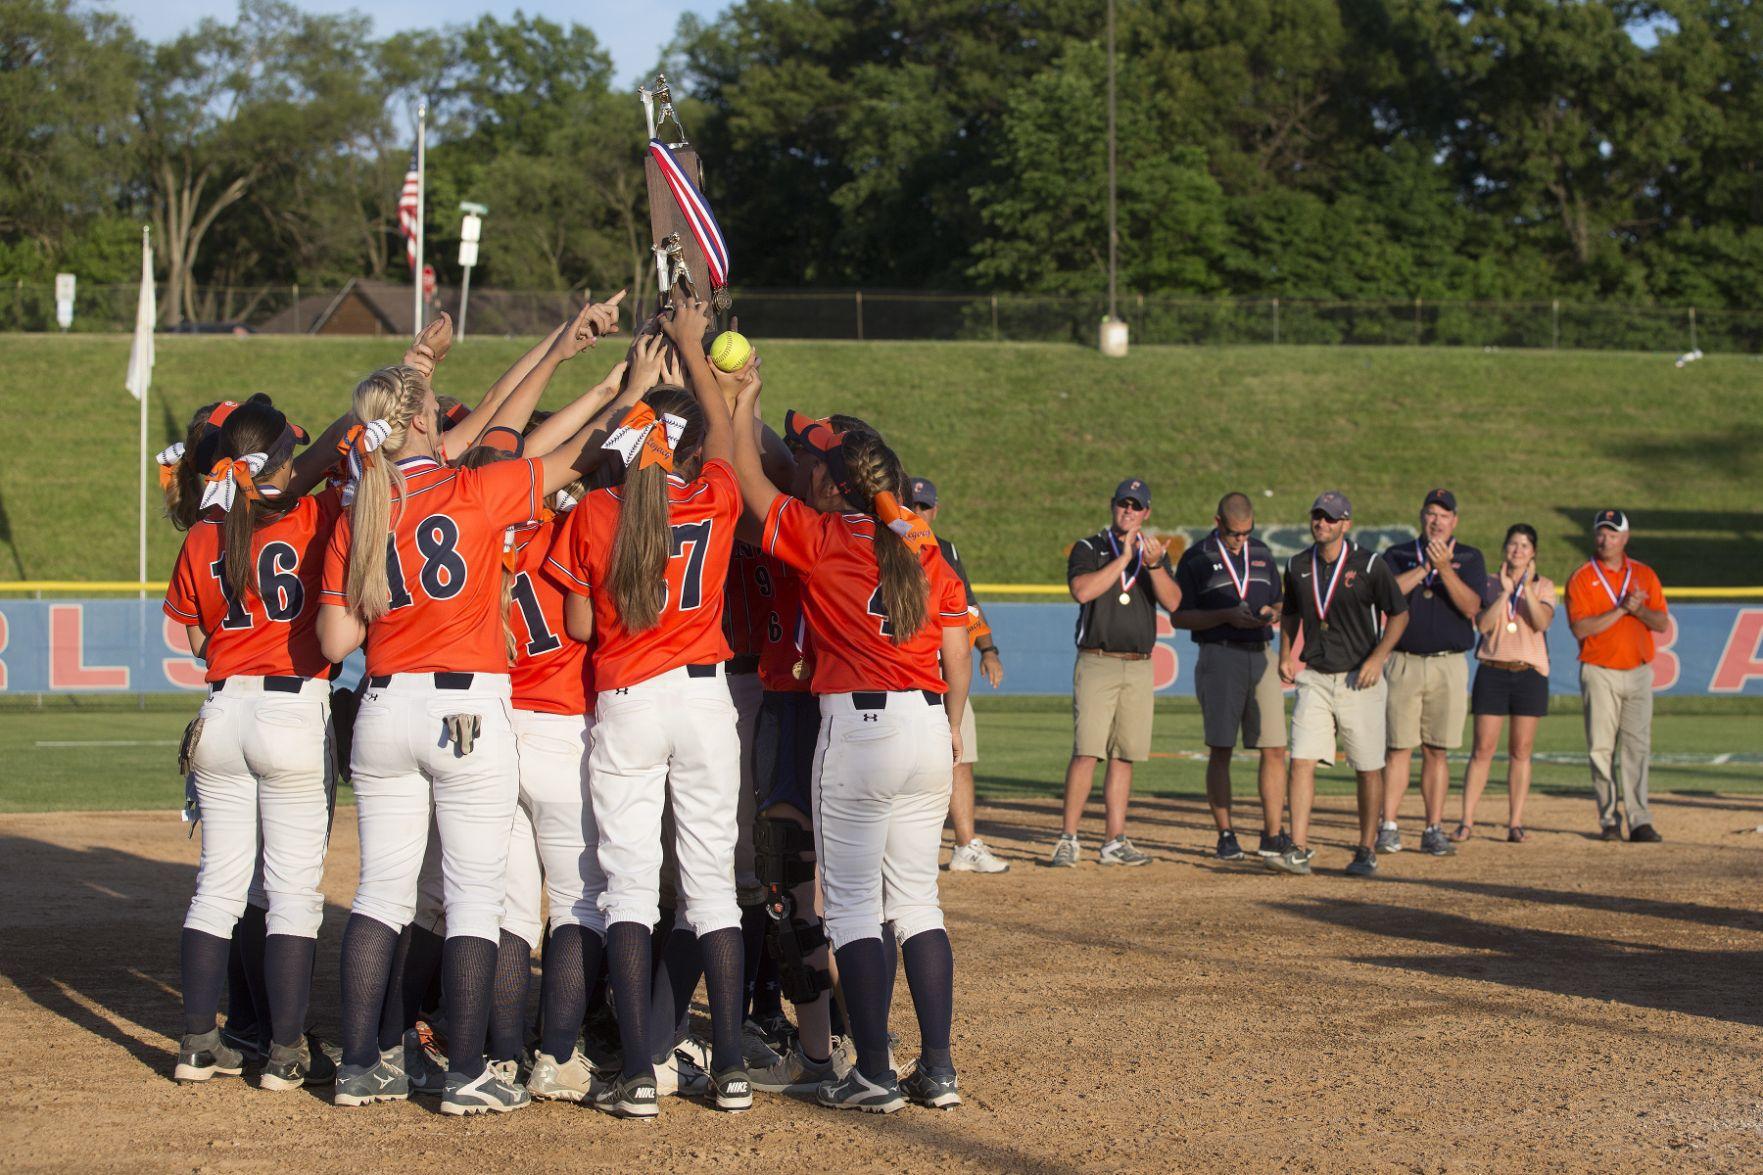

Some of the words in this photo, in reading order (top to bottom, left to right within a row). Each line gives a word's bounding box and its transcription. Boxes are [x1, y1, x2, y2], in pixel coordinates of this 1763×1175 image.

[210, 541, 305, 630] 16
[510, 570, 563, 657] 1
[768, 610, 783, 643] 6
[634, 1087, 656, 1099] NIKE
[726, 1081, 748, 1094] NIKE
